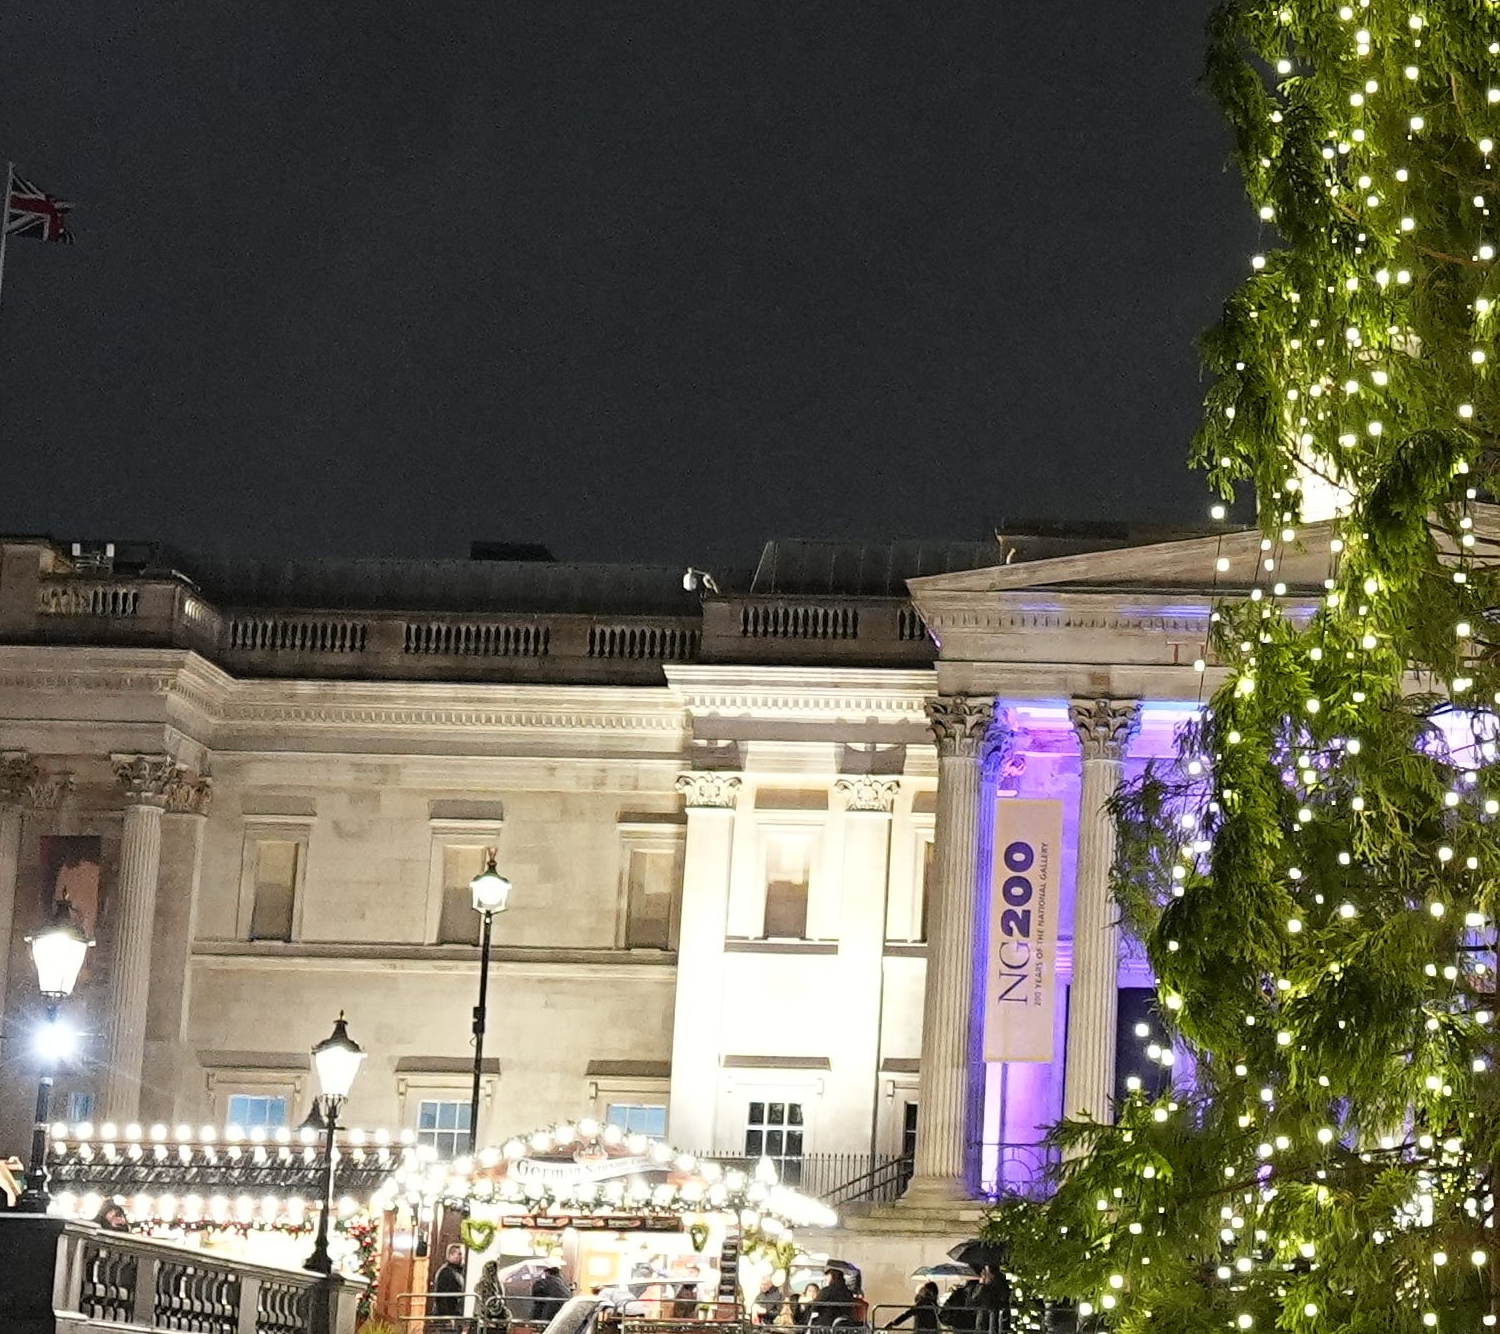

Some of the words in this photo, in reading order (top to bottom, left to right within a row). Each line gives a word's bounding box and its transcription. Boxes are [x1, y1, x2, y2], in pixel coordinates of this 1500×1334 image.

[1040, 842, 1049, 881] GALLERY
[1038, 884, 1047, 927] NATIONAL
[998, 841, 1034, 1004] NG200
[1036, 930, 1044, 945] THE
[1036, 947, 1044, 959] OF
[1035, 962, 1043, 989] YEARS
[1034, 992, 1042, 1006] 200
